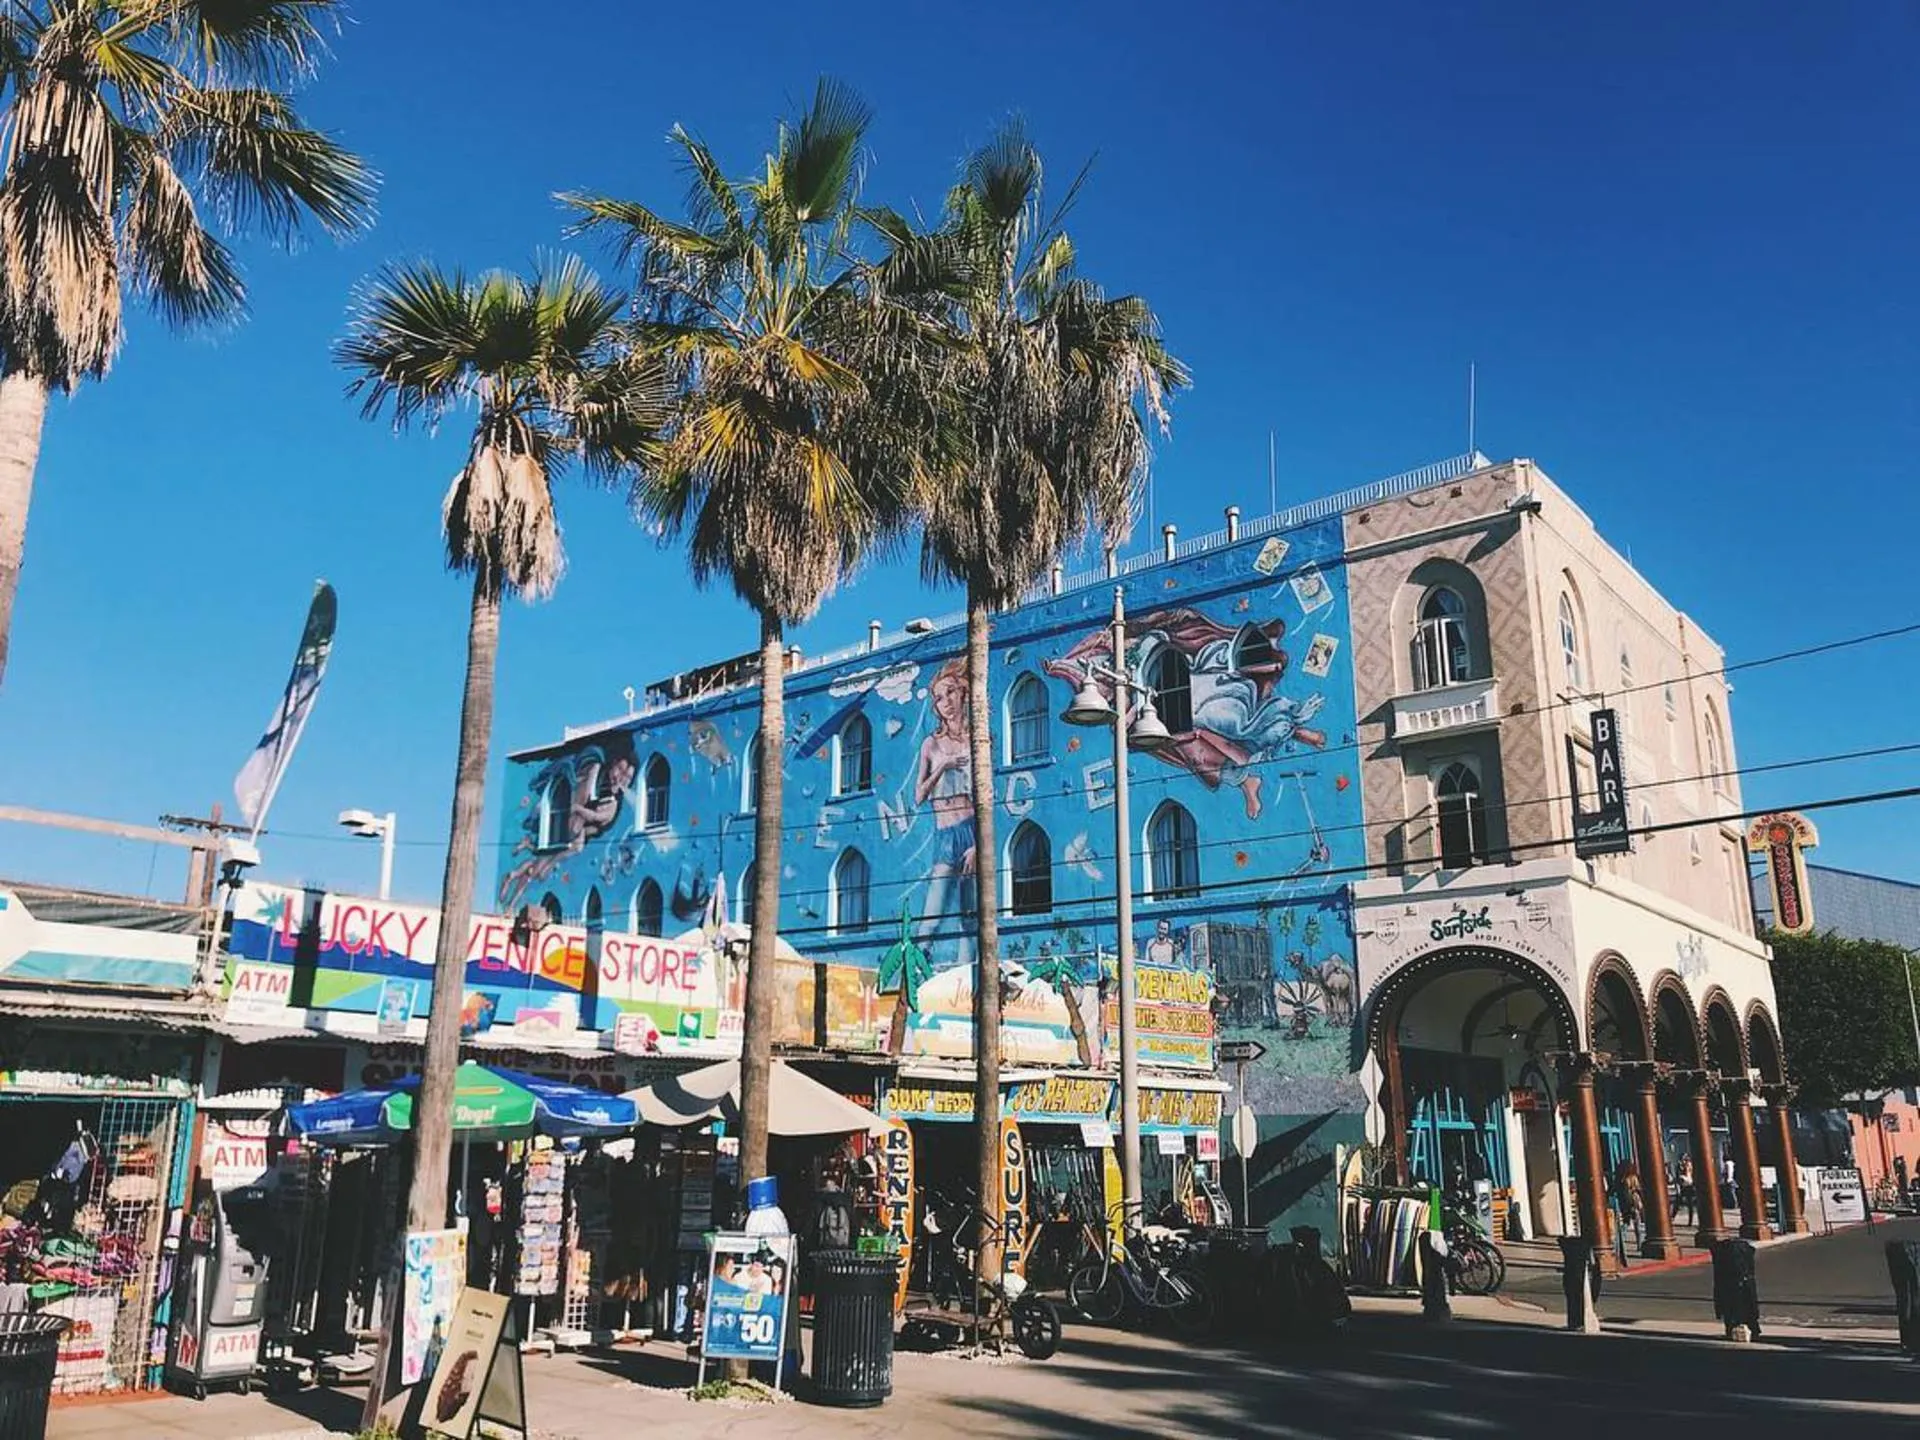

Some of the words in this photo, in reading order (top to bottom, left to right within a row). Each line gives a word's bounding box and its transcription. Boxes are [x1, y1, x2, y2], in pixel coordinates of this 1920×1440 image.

[1596, 718, 1619, 804] BAR
[1429, 906, 1493, 942] Surfside
[279, 895, 428, 962] LUCKY
[601, 938, 699, 991] STORE
[235, 970, 290, 996] ATM
[1135, 967, 1209, 1004] RENTALS
[719, 1015, 743, 1032] AT
[214, 1145, 266, 1168] ATM
[1821, 1170, 1858, 1180] PUBLIC
[1821, 1181, 1861, 1191] PARKING
[247, 1190, 265, 1200] ATM
[214, 1333, 257, 1354] ATM
